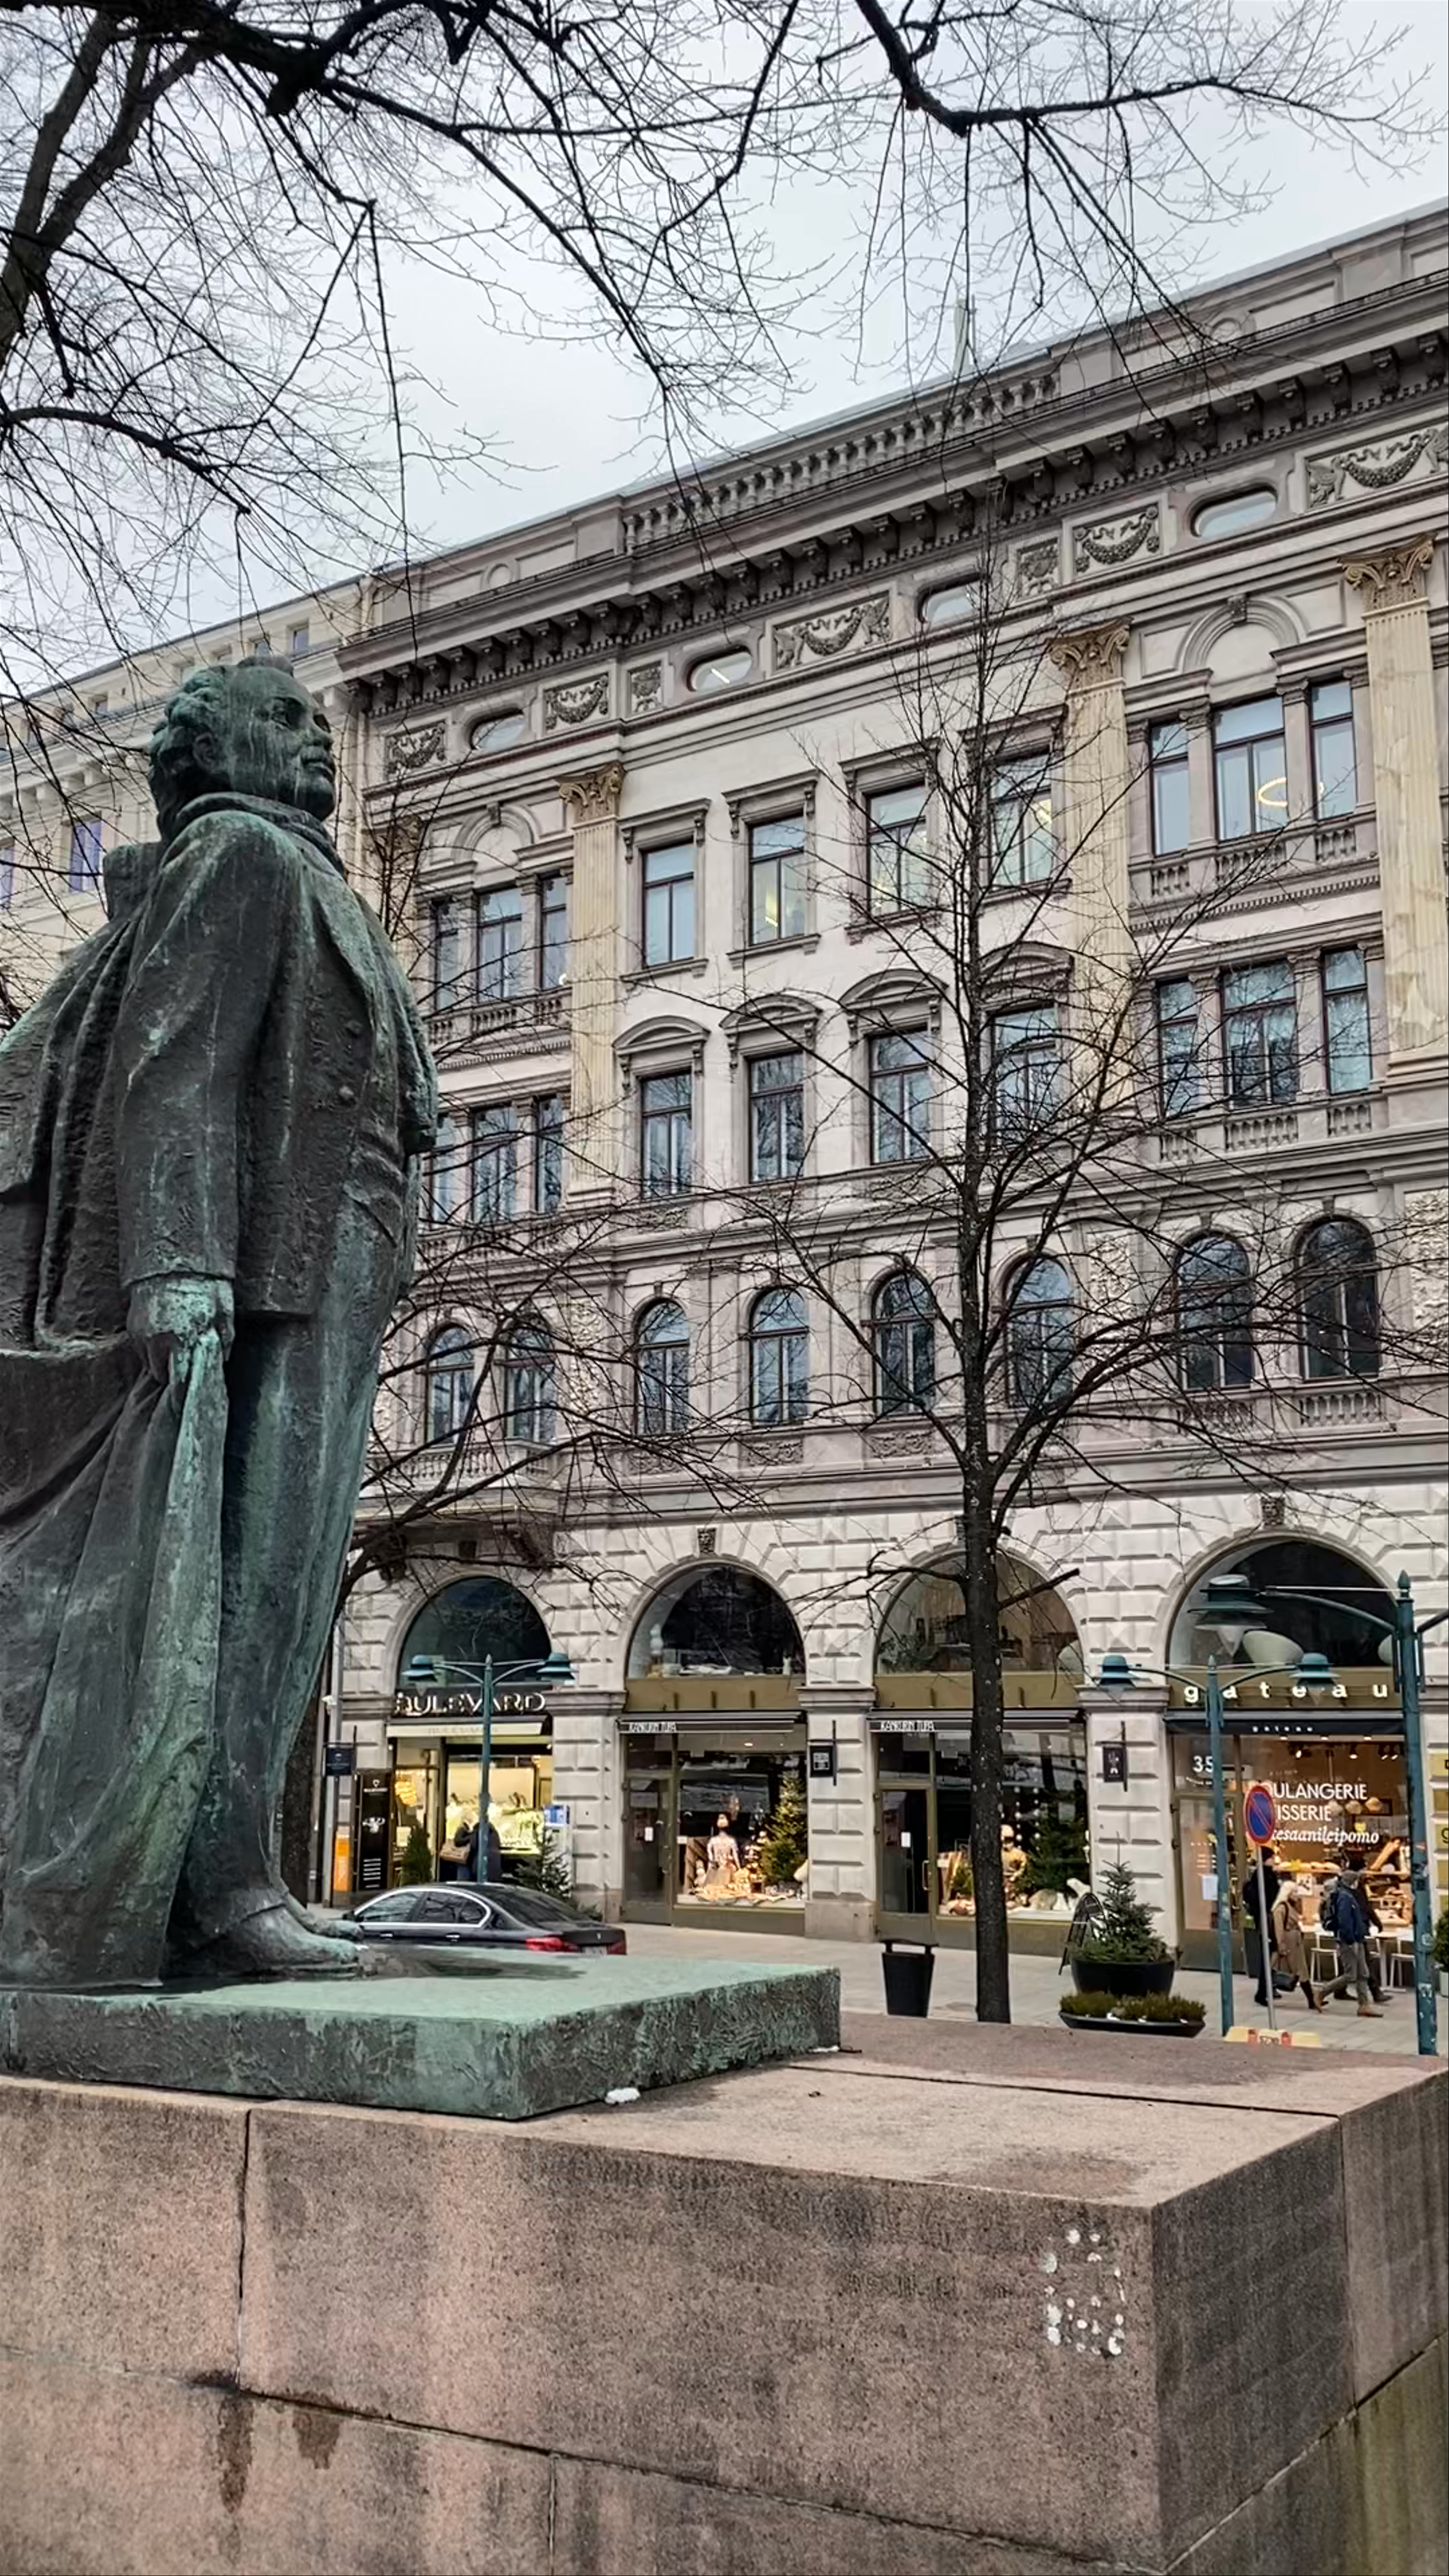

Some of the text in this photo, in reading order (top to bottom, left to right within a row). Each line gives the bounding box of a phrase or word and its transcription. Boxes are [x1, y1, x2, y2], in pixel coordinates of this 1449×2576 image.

[1184, 1681, 1388, 1702] gateau
[1193, 1755, 1213, 1772] 35
[1259, 1782, 1367, 1799] OULANGERIE
[1277, 1804, 1333, 1821] ISSERIE
[1272, 1825, 1379, 1846] tesaanileipomo
